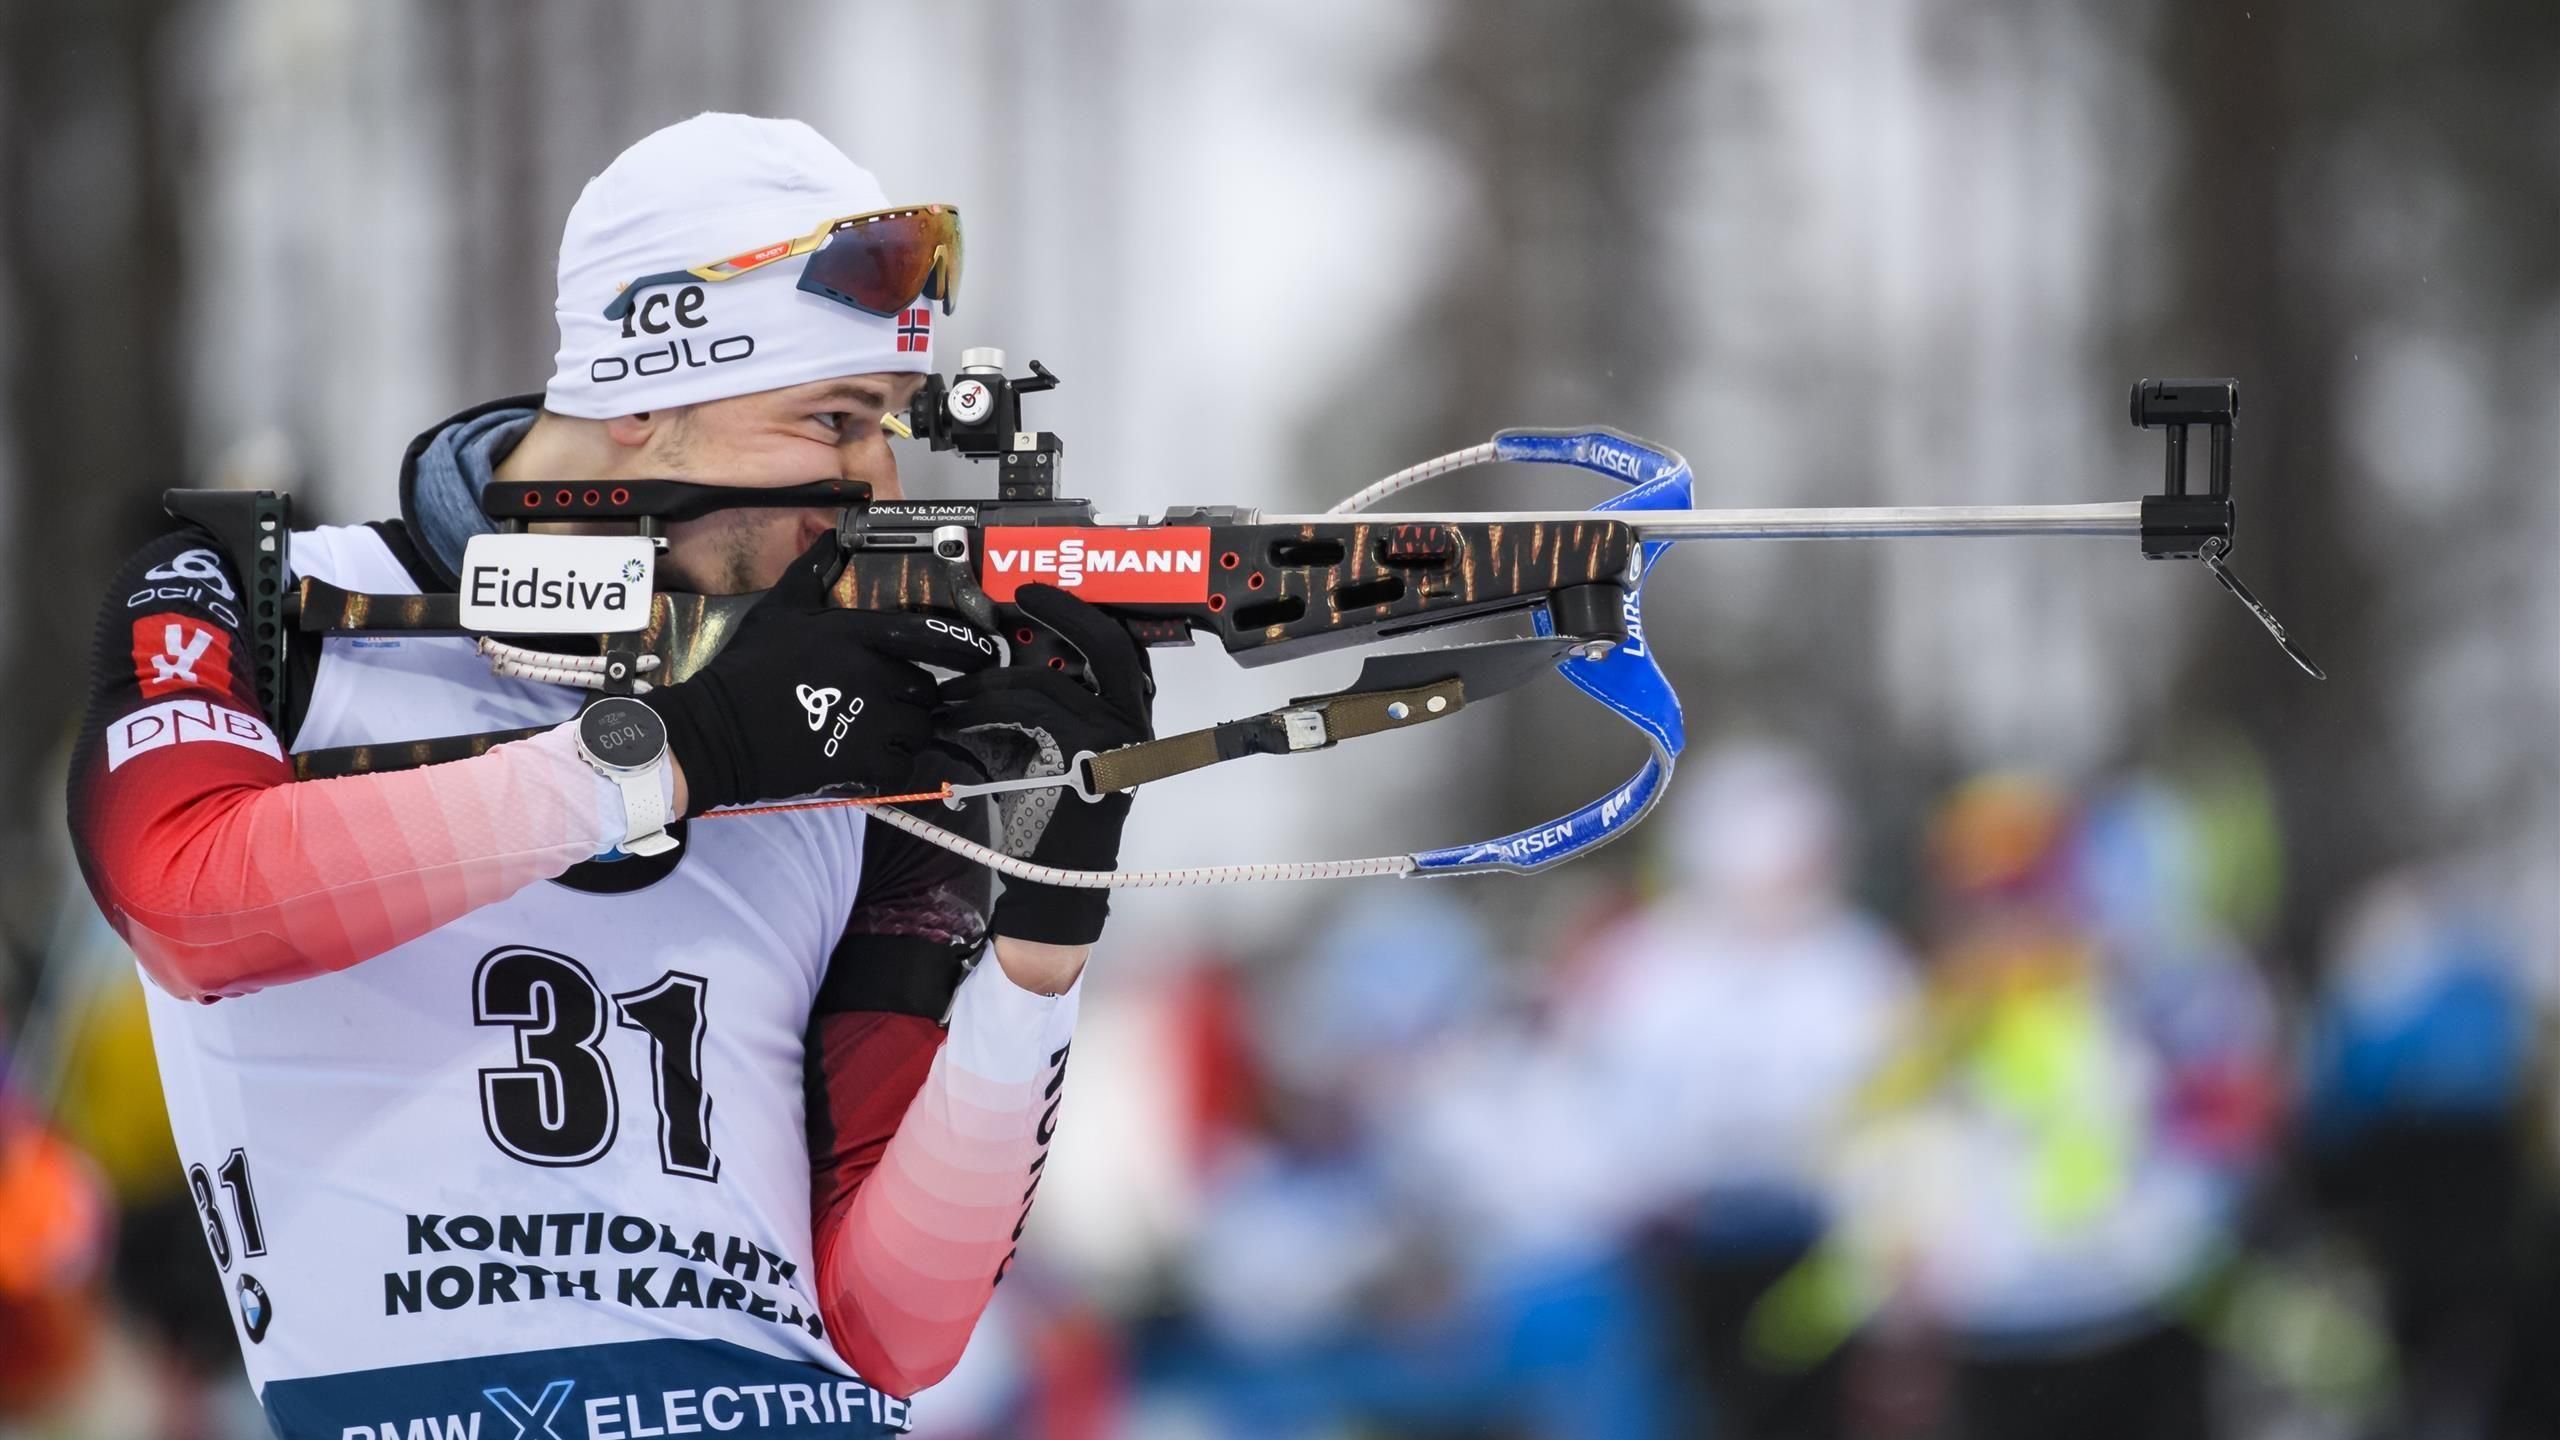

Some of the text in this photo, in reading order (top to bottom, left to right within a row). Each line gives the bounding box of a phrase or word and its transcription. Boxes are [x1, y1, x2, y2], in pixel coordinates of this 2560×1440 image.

[591, 335, 754, 383] odlo
[868, 506, 976, 515] ONKL'U & TANT'A
[988, 539, 1202, 587] VIESSMANN
[471, 566, 627, 611] Eidsiva
[925, 619, 993, 655] odlo
[1623, 590, 1645, 658] LARS
[126, 702, 263, 748] DNB
[599, 723, 645, 750] 16:03
[824, 697, 864, 757] odlo
[472, 944, 720, 1184] 31
[189, 1147, 268, 1274] 31
[384, 1262, 601, 1316] NORTH
[618, 1266, 824, 1340] KARE
